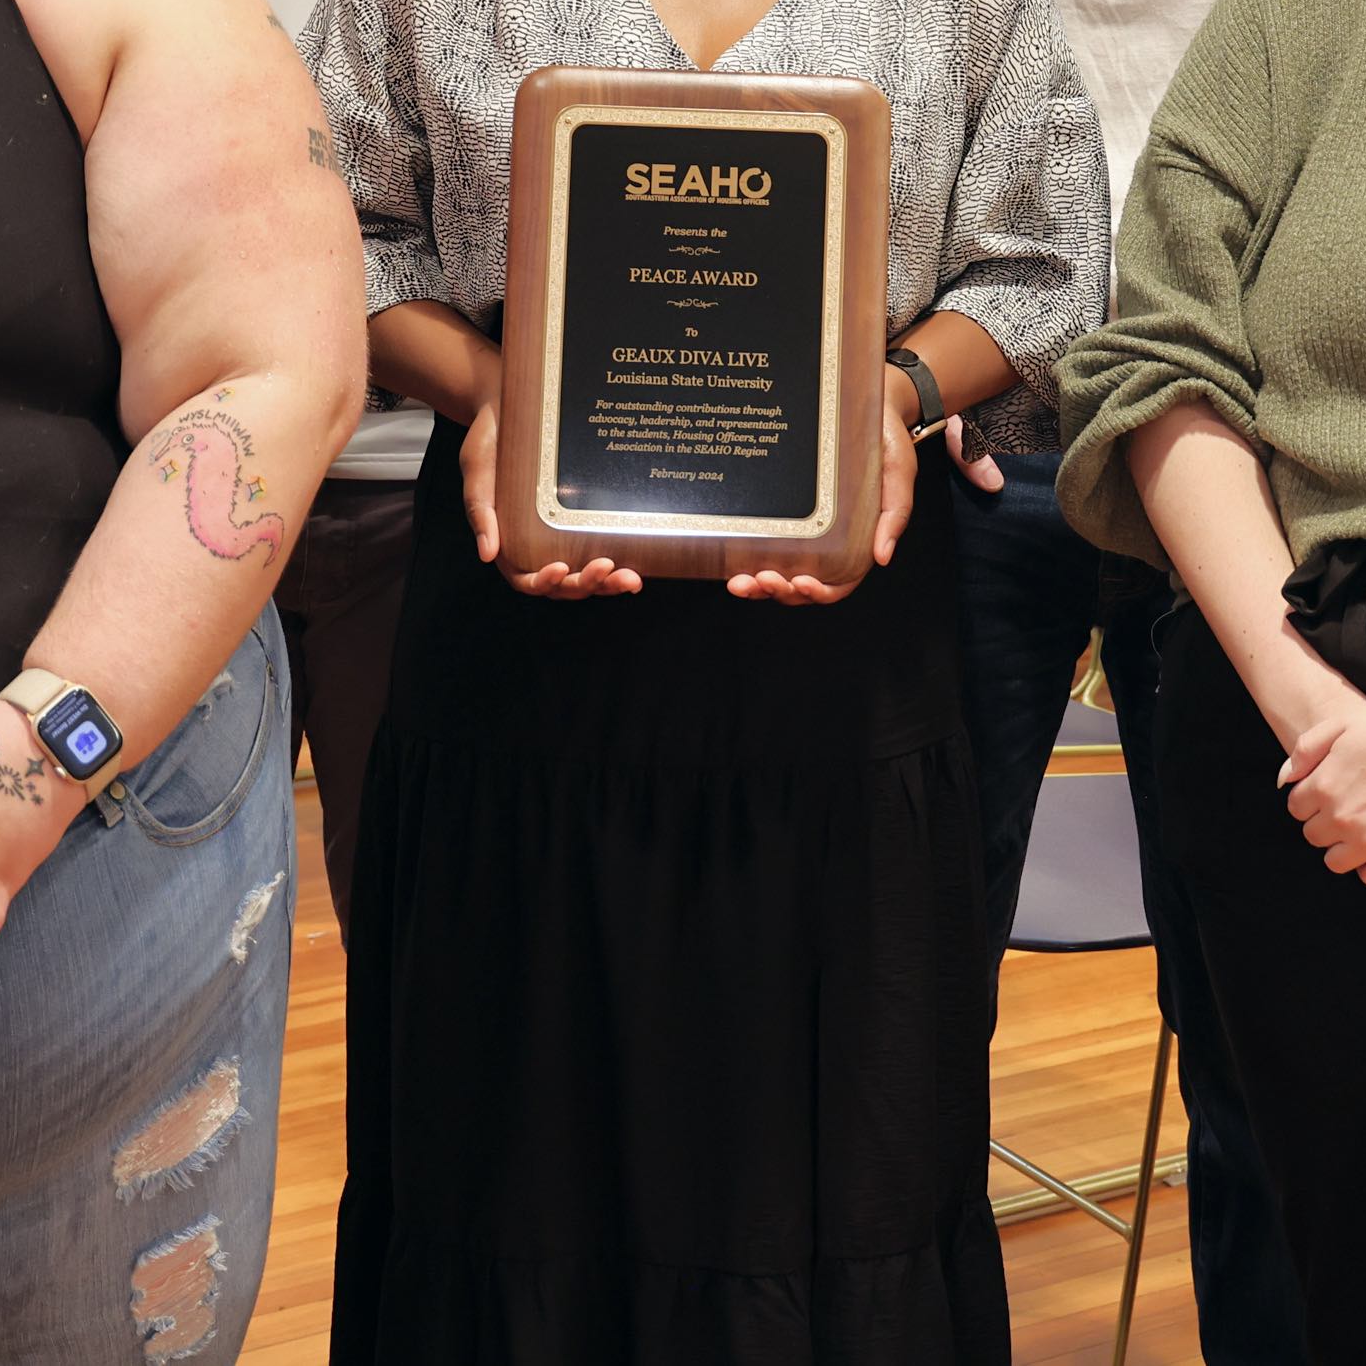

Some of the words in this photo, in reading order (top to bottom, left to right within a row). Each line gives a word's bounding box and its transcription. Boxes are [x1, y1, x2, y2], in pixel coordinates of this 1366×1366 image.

[625, 163, 772, 199] SEAHO
[663, 226, 708, 237] Presents
[710, 227, 728, 238] the
[629, 267, 686, 284] PEACE
[690, 270, 758, 287] AWARD
[685, 327, 698, 338] To
[612, 347, 676, 365] GEAUX
[679, 349, 724, 366] DIVA
[727, 352, 769, 368] LIVE
[606, 371, 668, 385] Louisiana
[671, 373, 704, 387] State
[707, 375, 773, 392] University
[595, 399, 614, 409] For
[615, 401, 674, 415] outstanding
[676, 403, 741, 415] contributions
[742, 405, 782, 418] through
[588, 413, 637, 426] advocacy,
[639, 414, 693, 429] leadership,
[695, 418, 715, 428] and
[716, 419, 788, 431] representation
[597, 428, 608, 437] to
[609, 428, 625, 438] the
[626, 429, 670, 441] students,
[672, 430, 714, 443] Housing
[716, 431, 757, 444] Officers,
[758, 433, 779, 444] and
[606, 441, 663, 453] Association
[665, 443, 675, 453] in
[676, 444, 692, 454] the
[693, 444, 732, 455] SEAHO
[733, 446, 768, 458] Region
[649, 468, 696, 482] February
[698, 471, 724, 482] 2024
